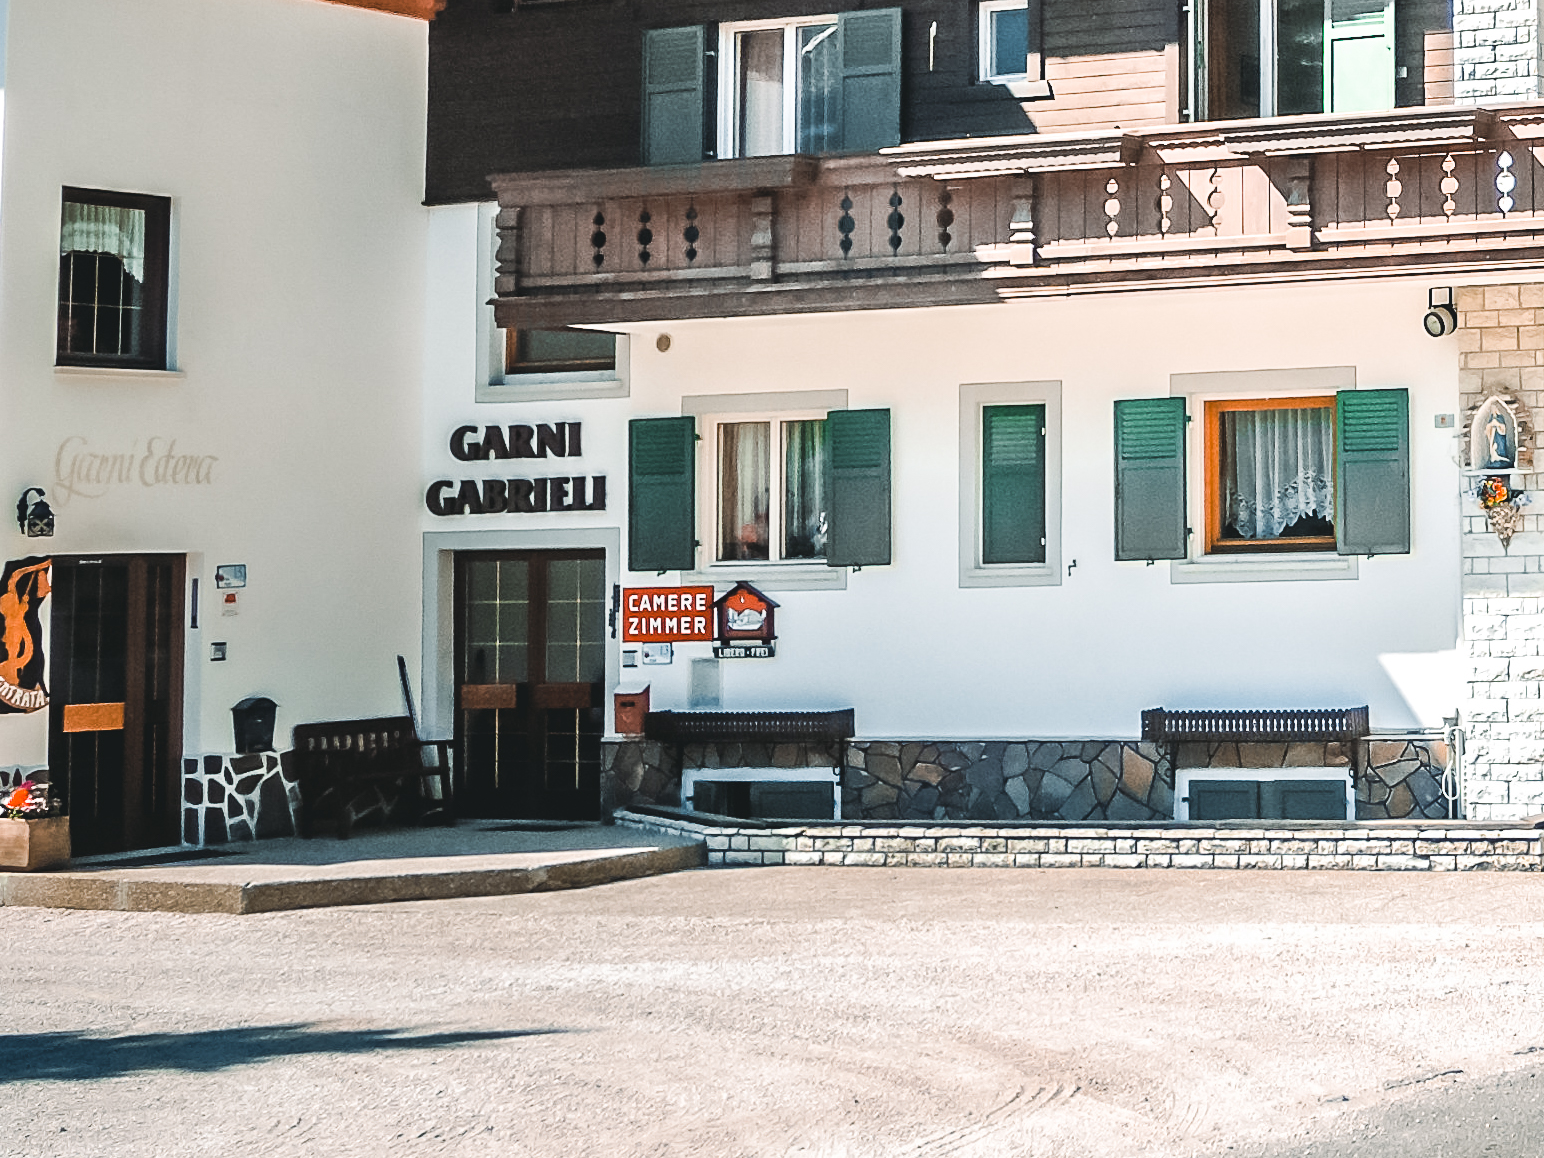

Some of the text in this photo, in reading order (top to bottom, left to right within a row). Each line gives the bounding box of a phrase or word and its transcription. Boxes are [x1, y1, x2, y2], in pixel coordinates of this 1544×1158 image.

[450, 422, 582, 461] GARNI
[52, 436, 138, 507] Garni
[425, 475, 606, 516] GABRIELI
[628, 593, 707, 612] CAMERE
[628, 616, 706, 635] ZIMMER
[0, 680, 46, 708] NTRATA
